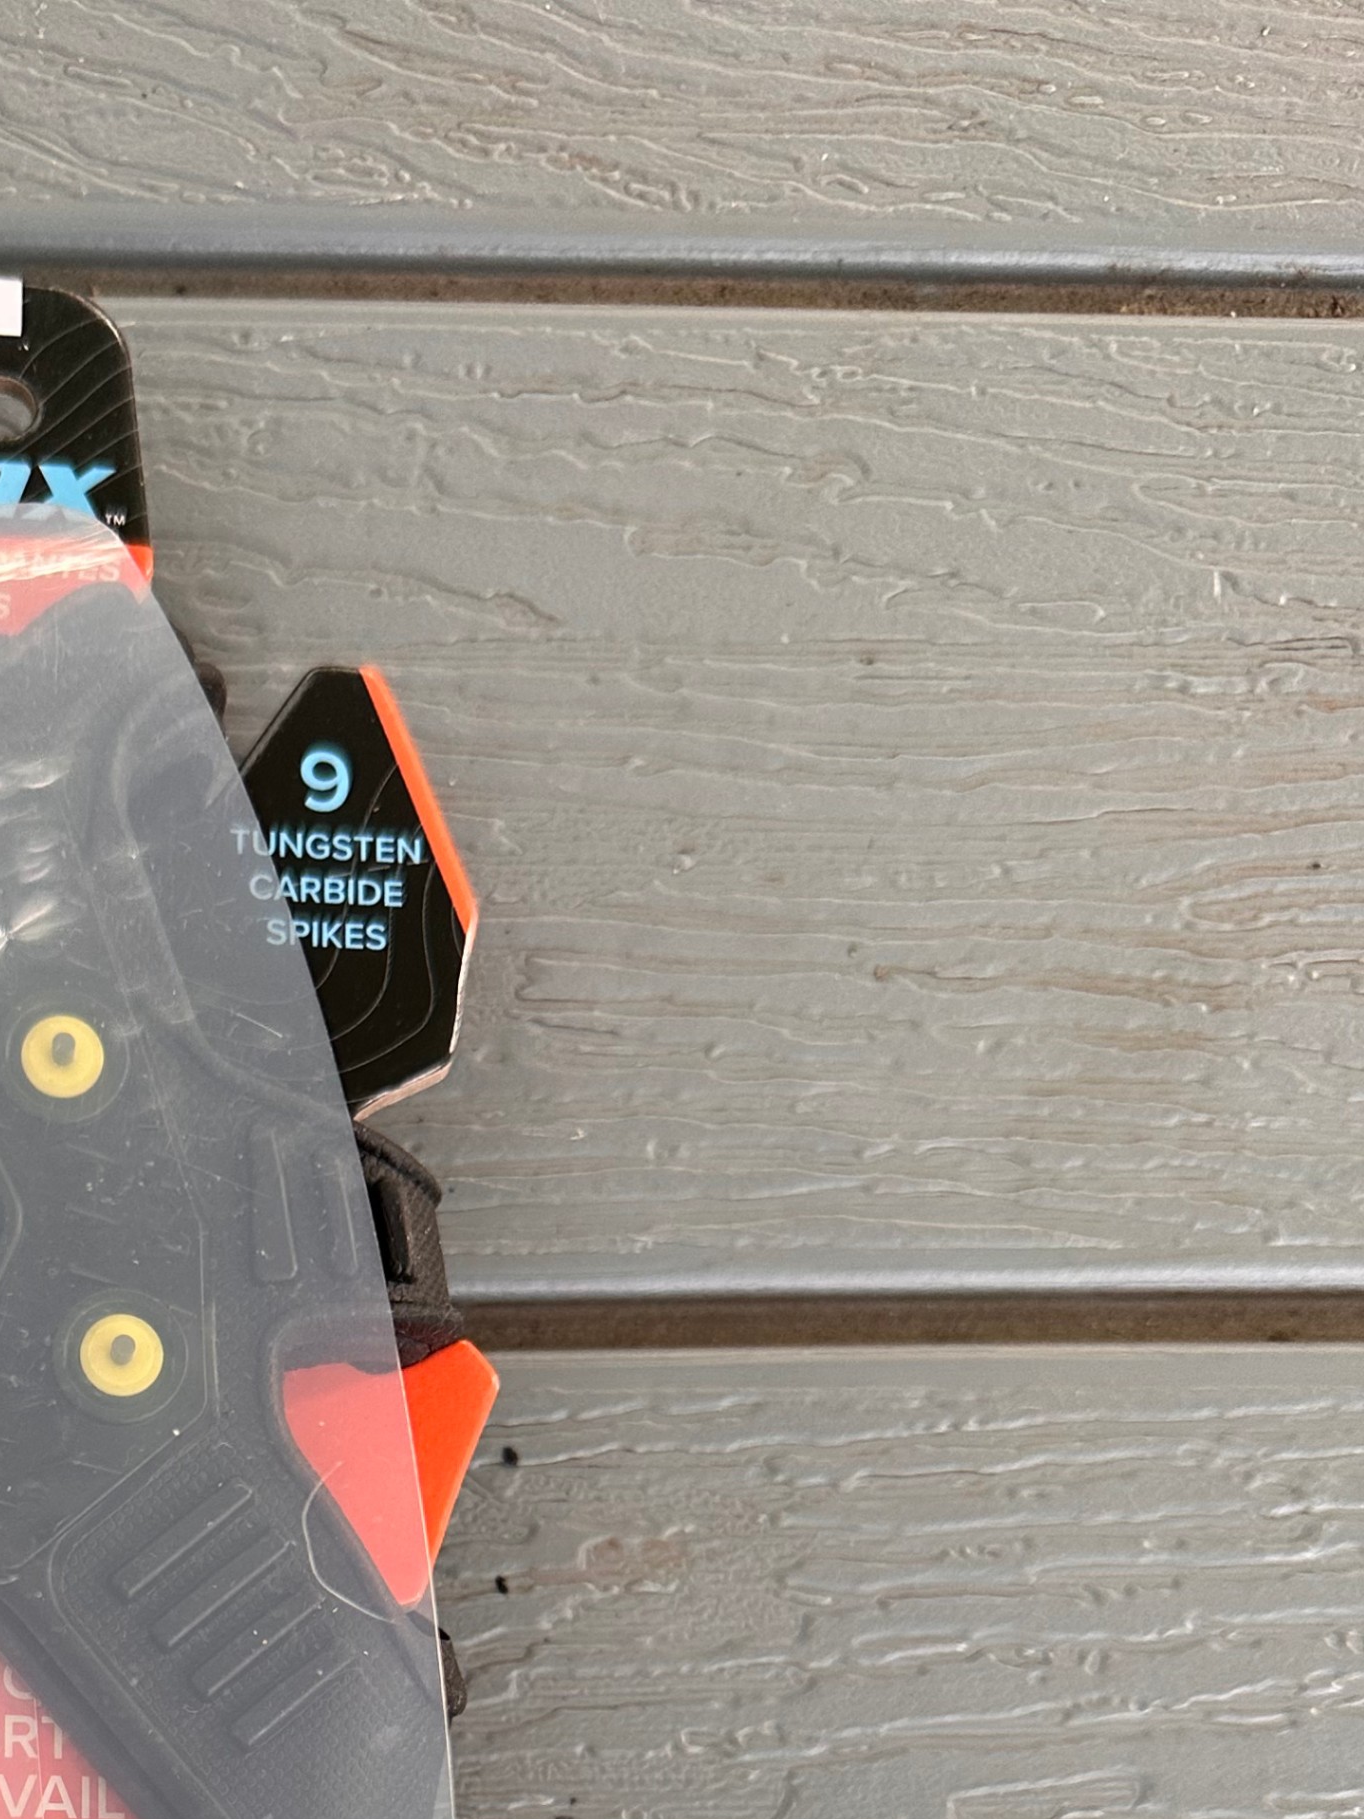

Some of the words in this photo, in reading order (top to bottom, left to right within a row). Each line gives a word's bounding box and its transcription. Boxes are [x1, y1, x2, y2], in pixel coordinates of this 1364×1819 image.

[300, 752, 350, 813] 9
[230, 828, 423, 865] TUNGSTEN
[249, 873, 404, 908] CARBIDE
[266, 918, 387, 951] SPIKES
